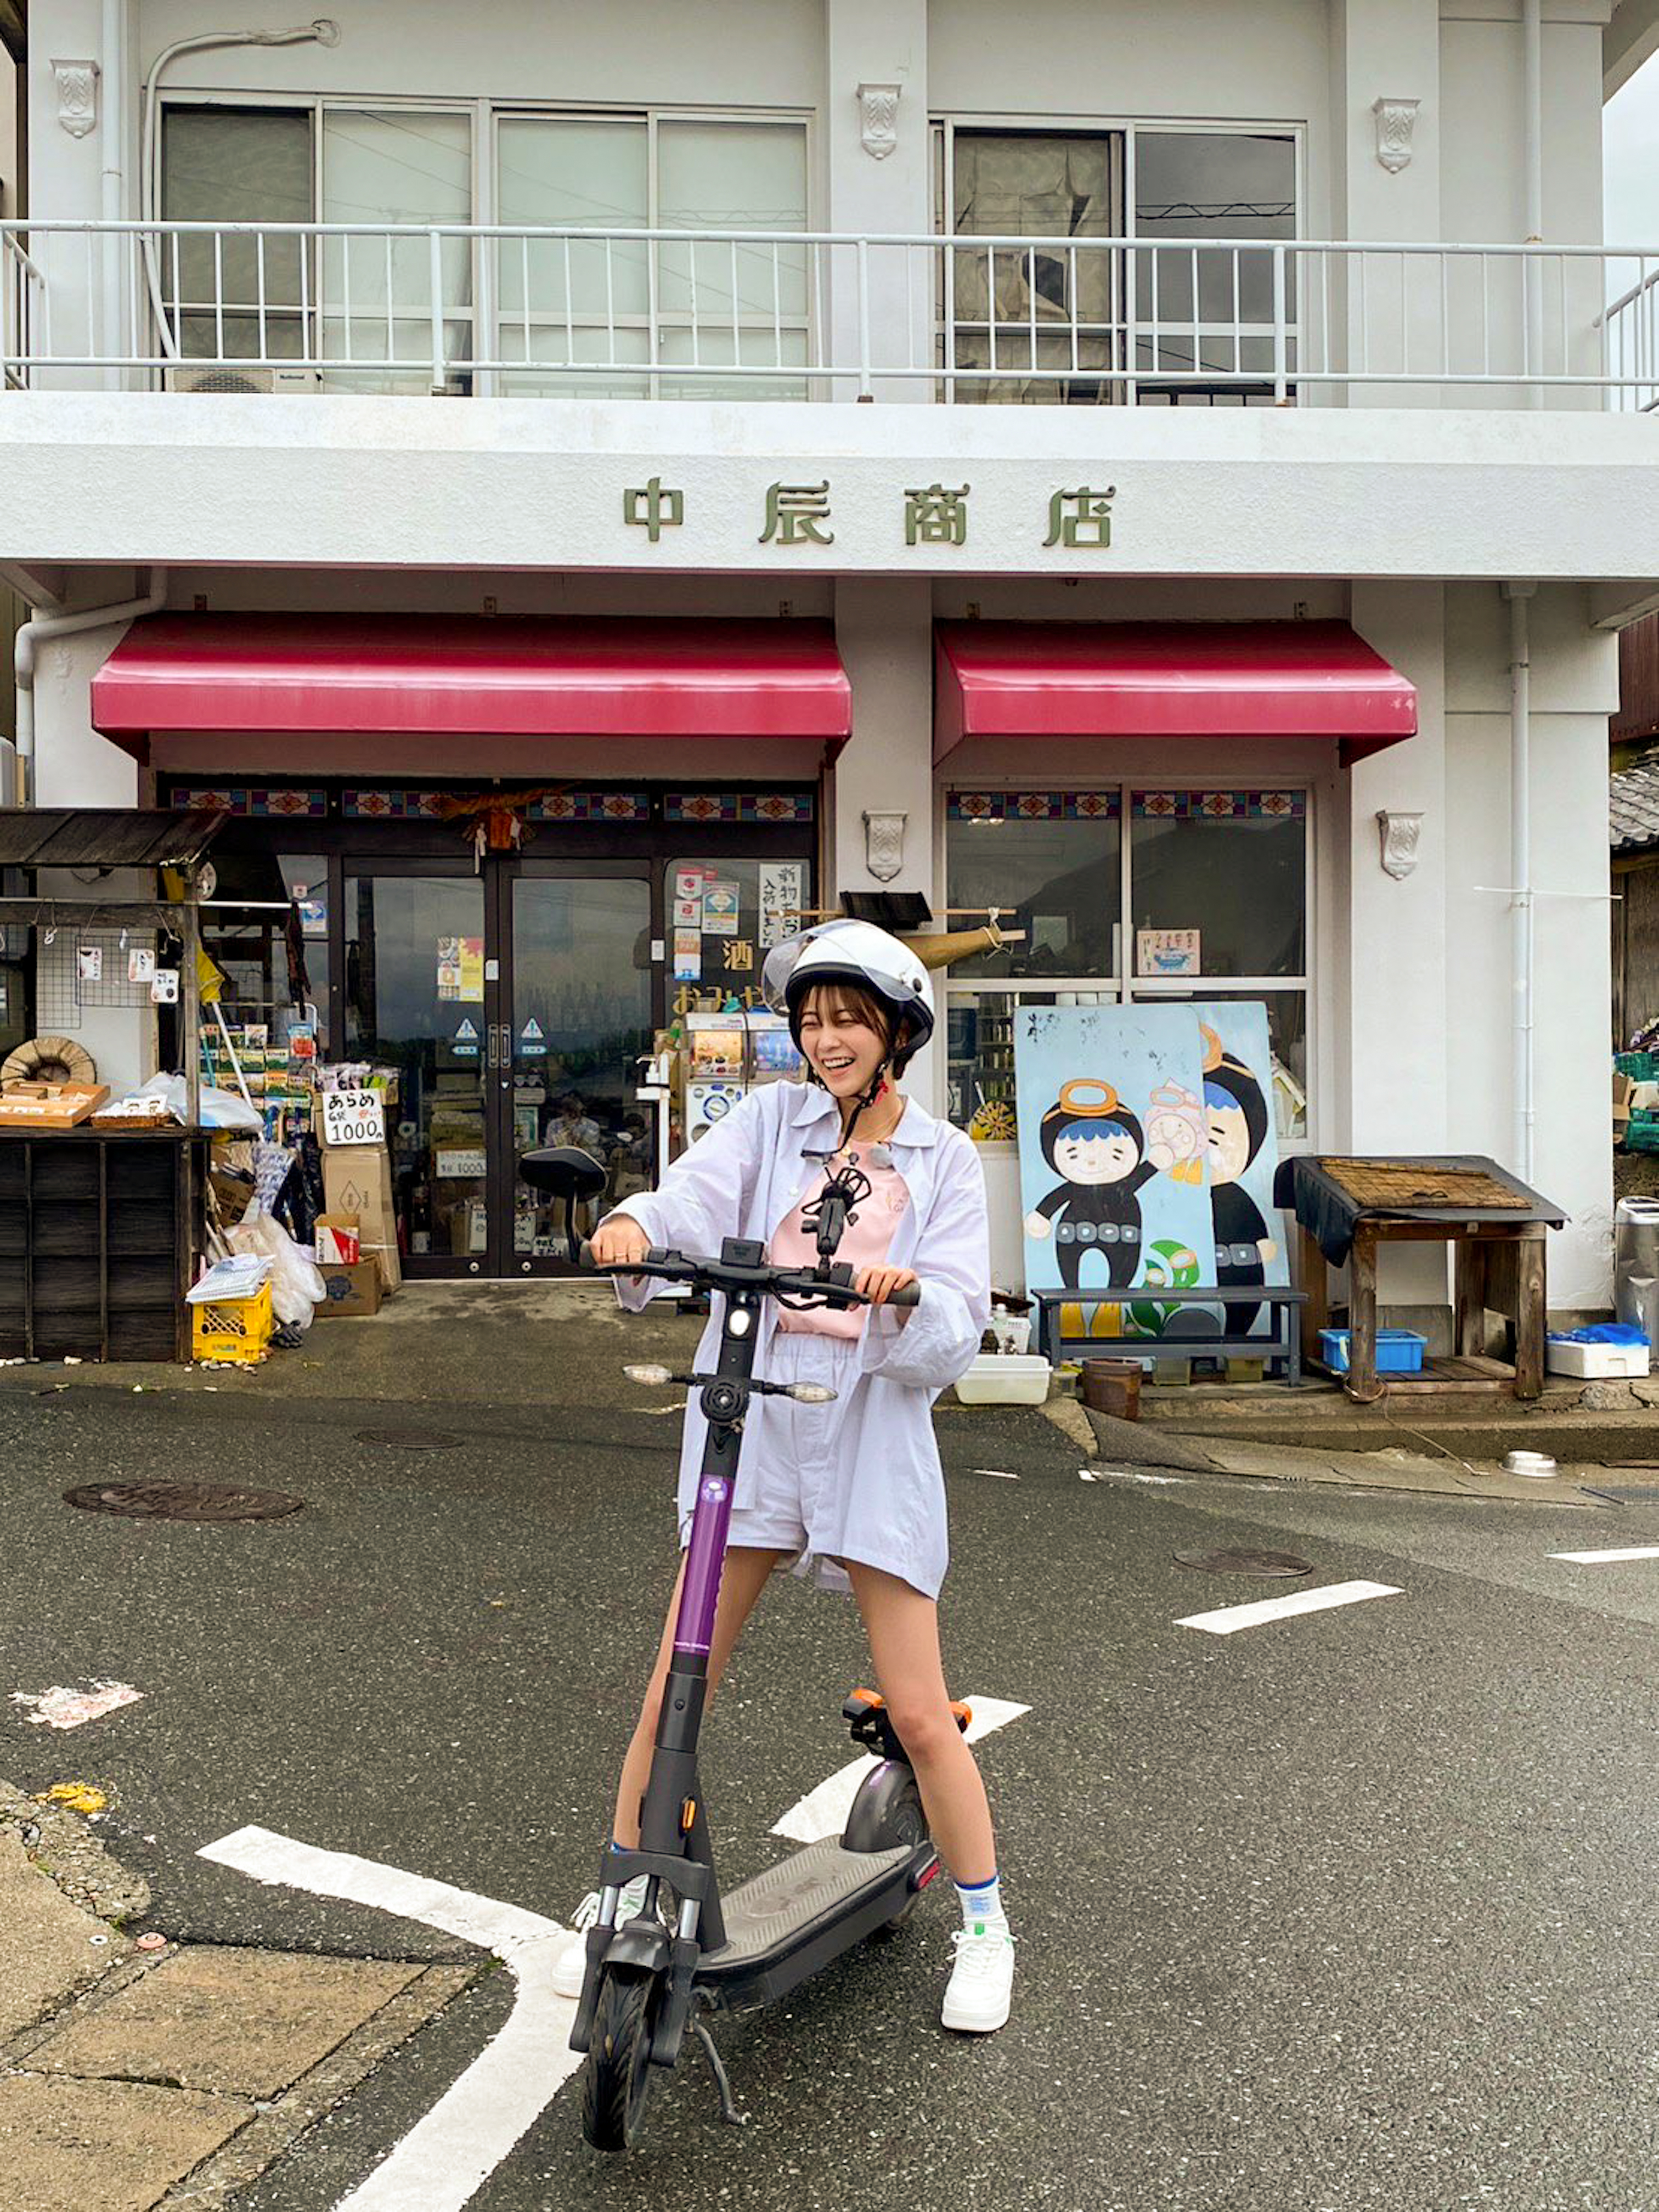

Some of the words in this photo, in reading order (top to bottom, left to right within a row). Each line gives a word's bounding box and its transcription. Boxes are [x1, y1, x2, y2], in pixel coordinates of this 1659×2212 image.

[624, 476, 1116, 548] 中辰商店
[723, 939, 754, 970] 酒
[329, 1092, 374, 1109] あらめ
